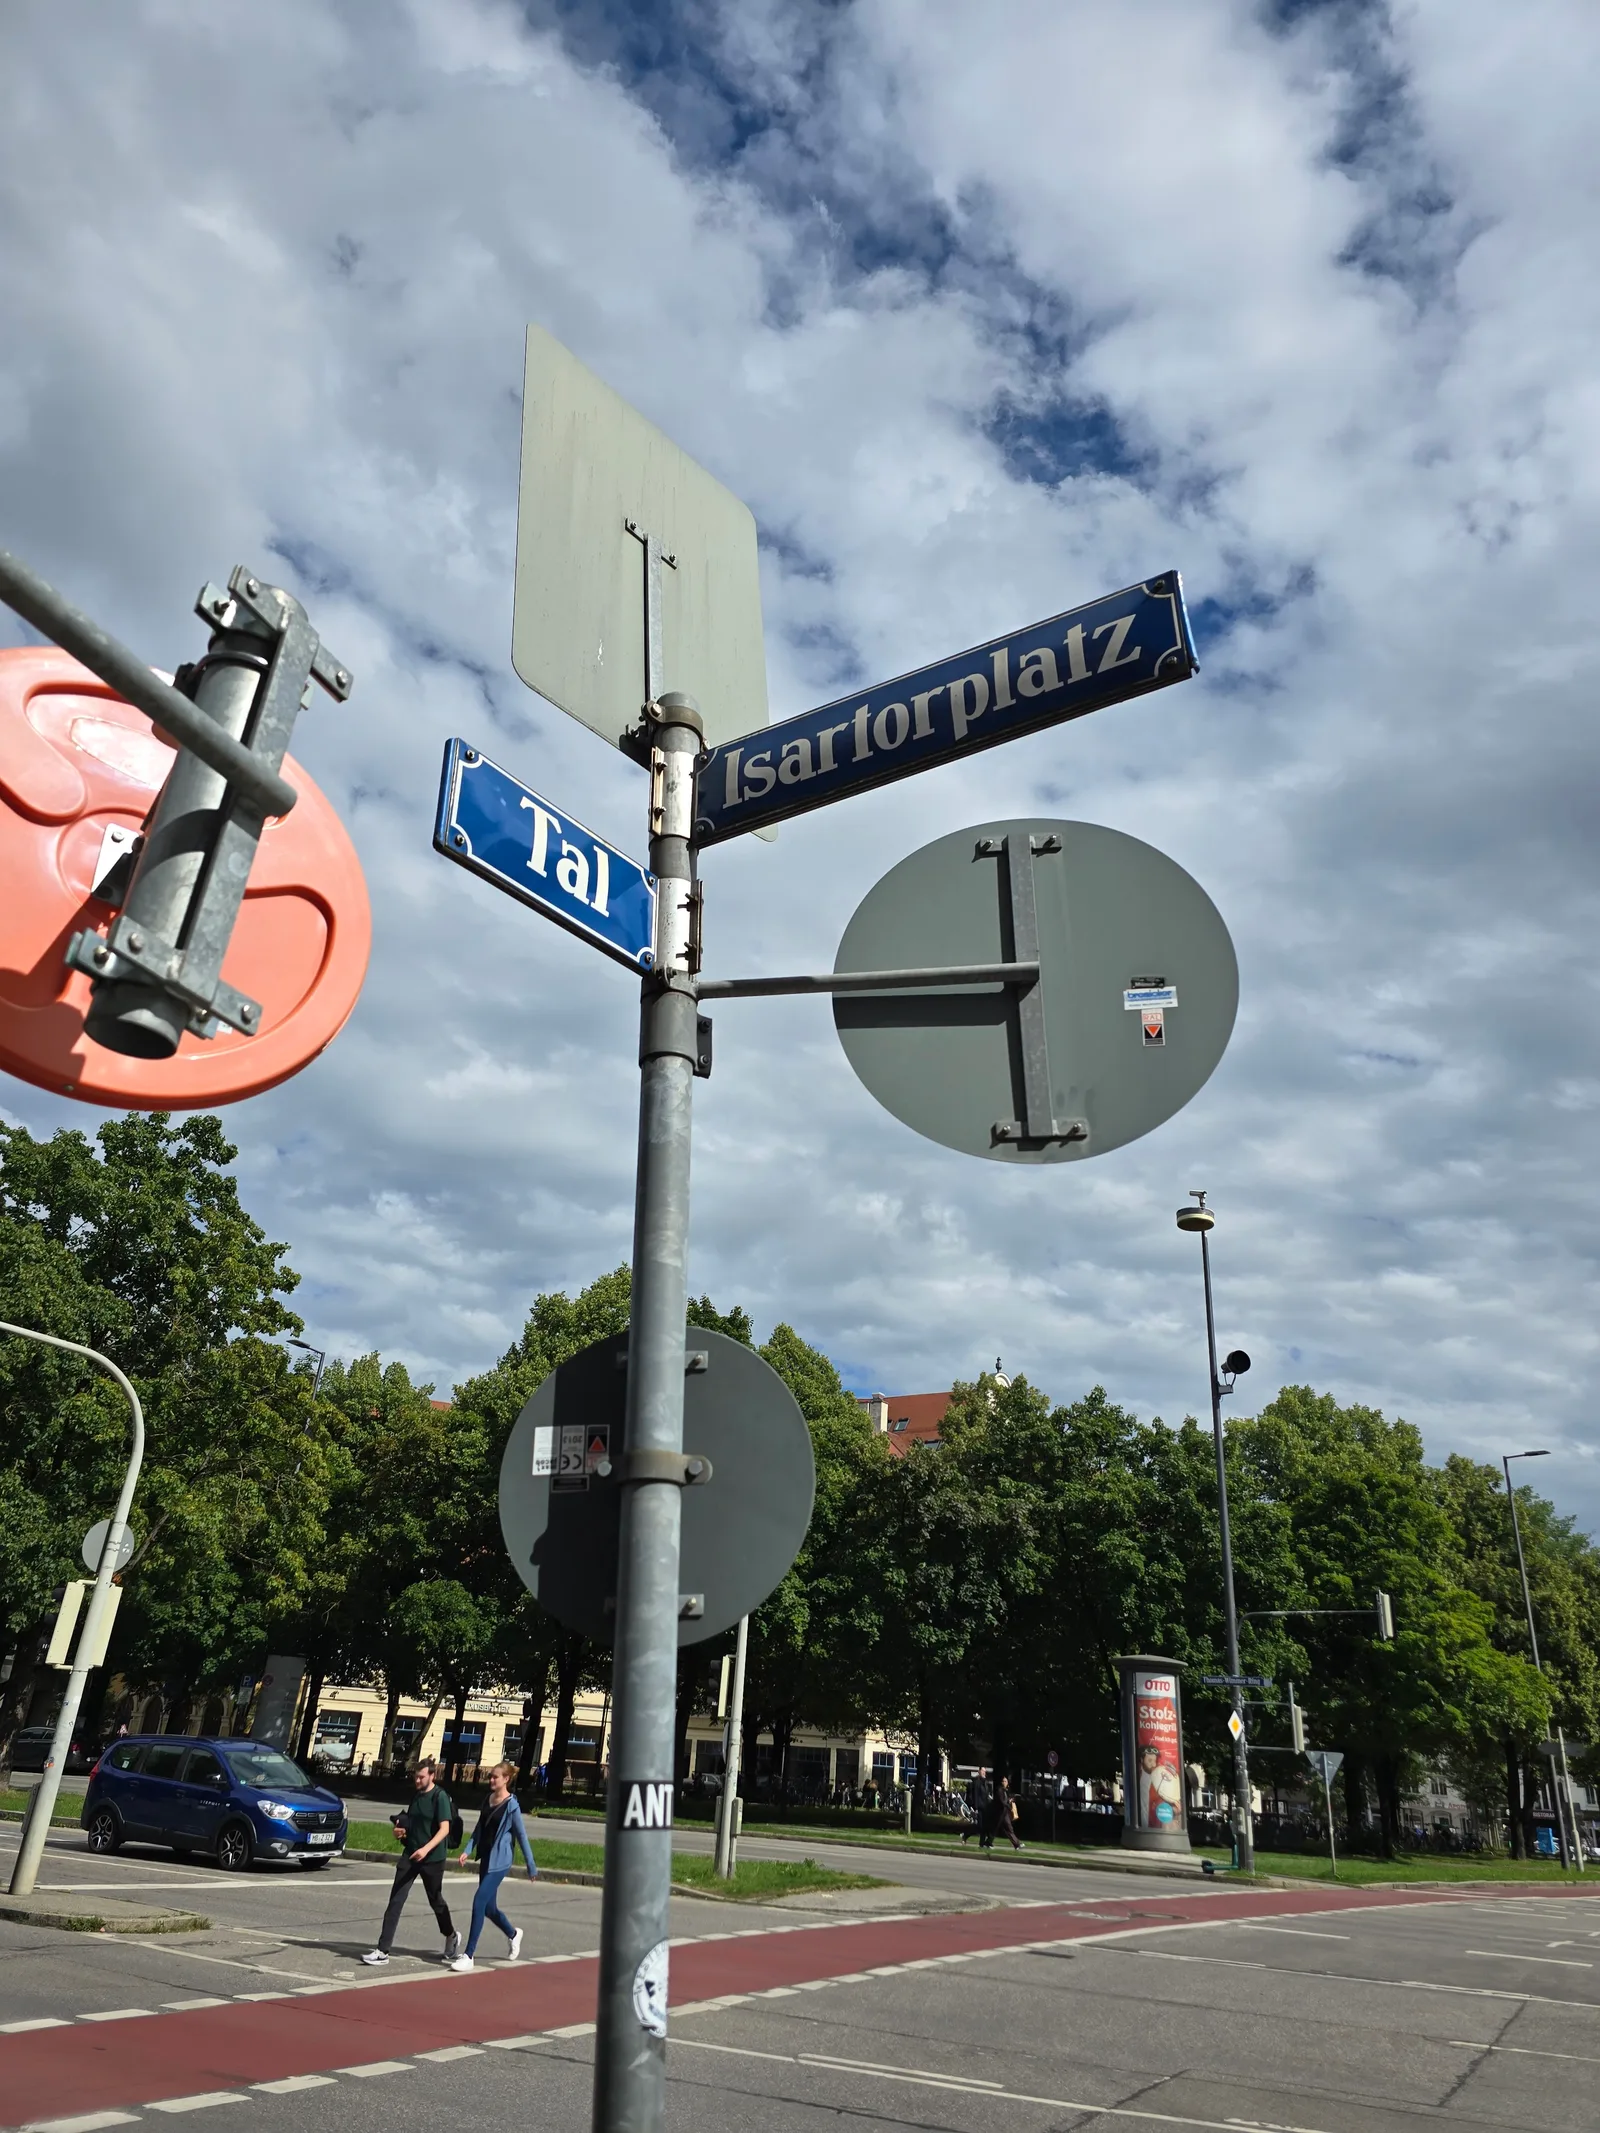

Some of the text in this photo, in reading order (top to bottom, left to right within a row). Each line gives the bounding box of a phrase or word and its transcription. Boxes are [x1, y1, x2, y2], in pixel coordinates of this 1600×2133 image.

[721, 613, 1143, 810] Isartorplatz
[518, 795, 610, 918] Tal
[1144, 1679, 1171, 1692] OTTO
[1202, 1676, 1261, 1685] Thomas-Wimmer-Ring
[1139, 1705, 1177, 1721] Stolz-
[623, 1783, 674, 1828] ANT
